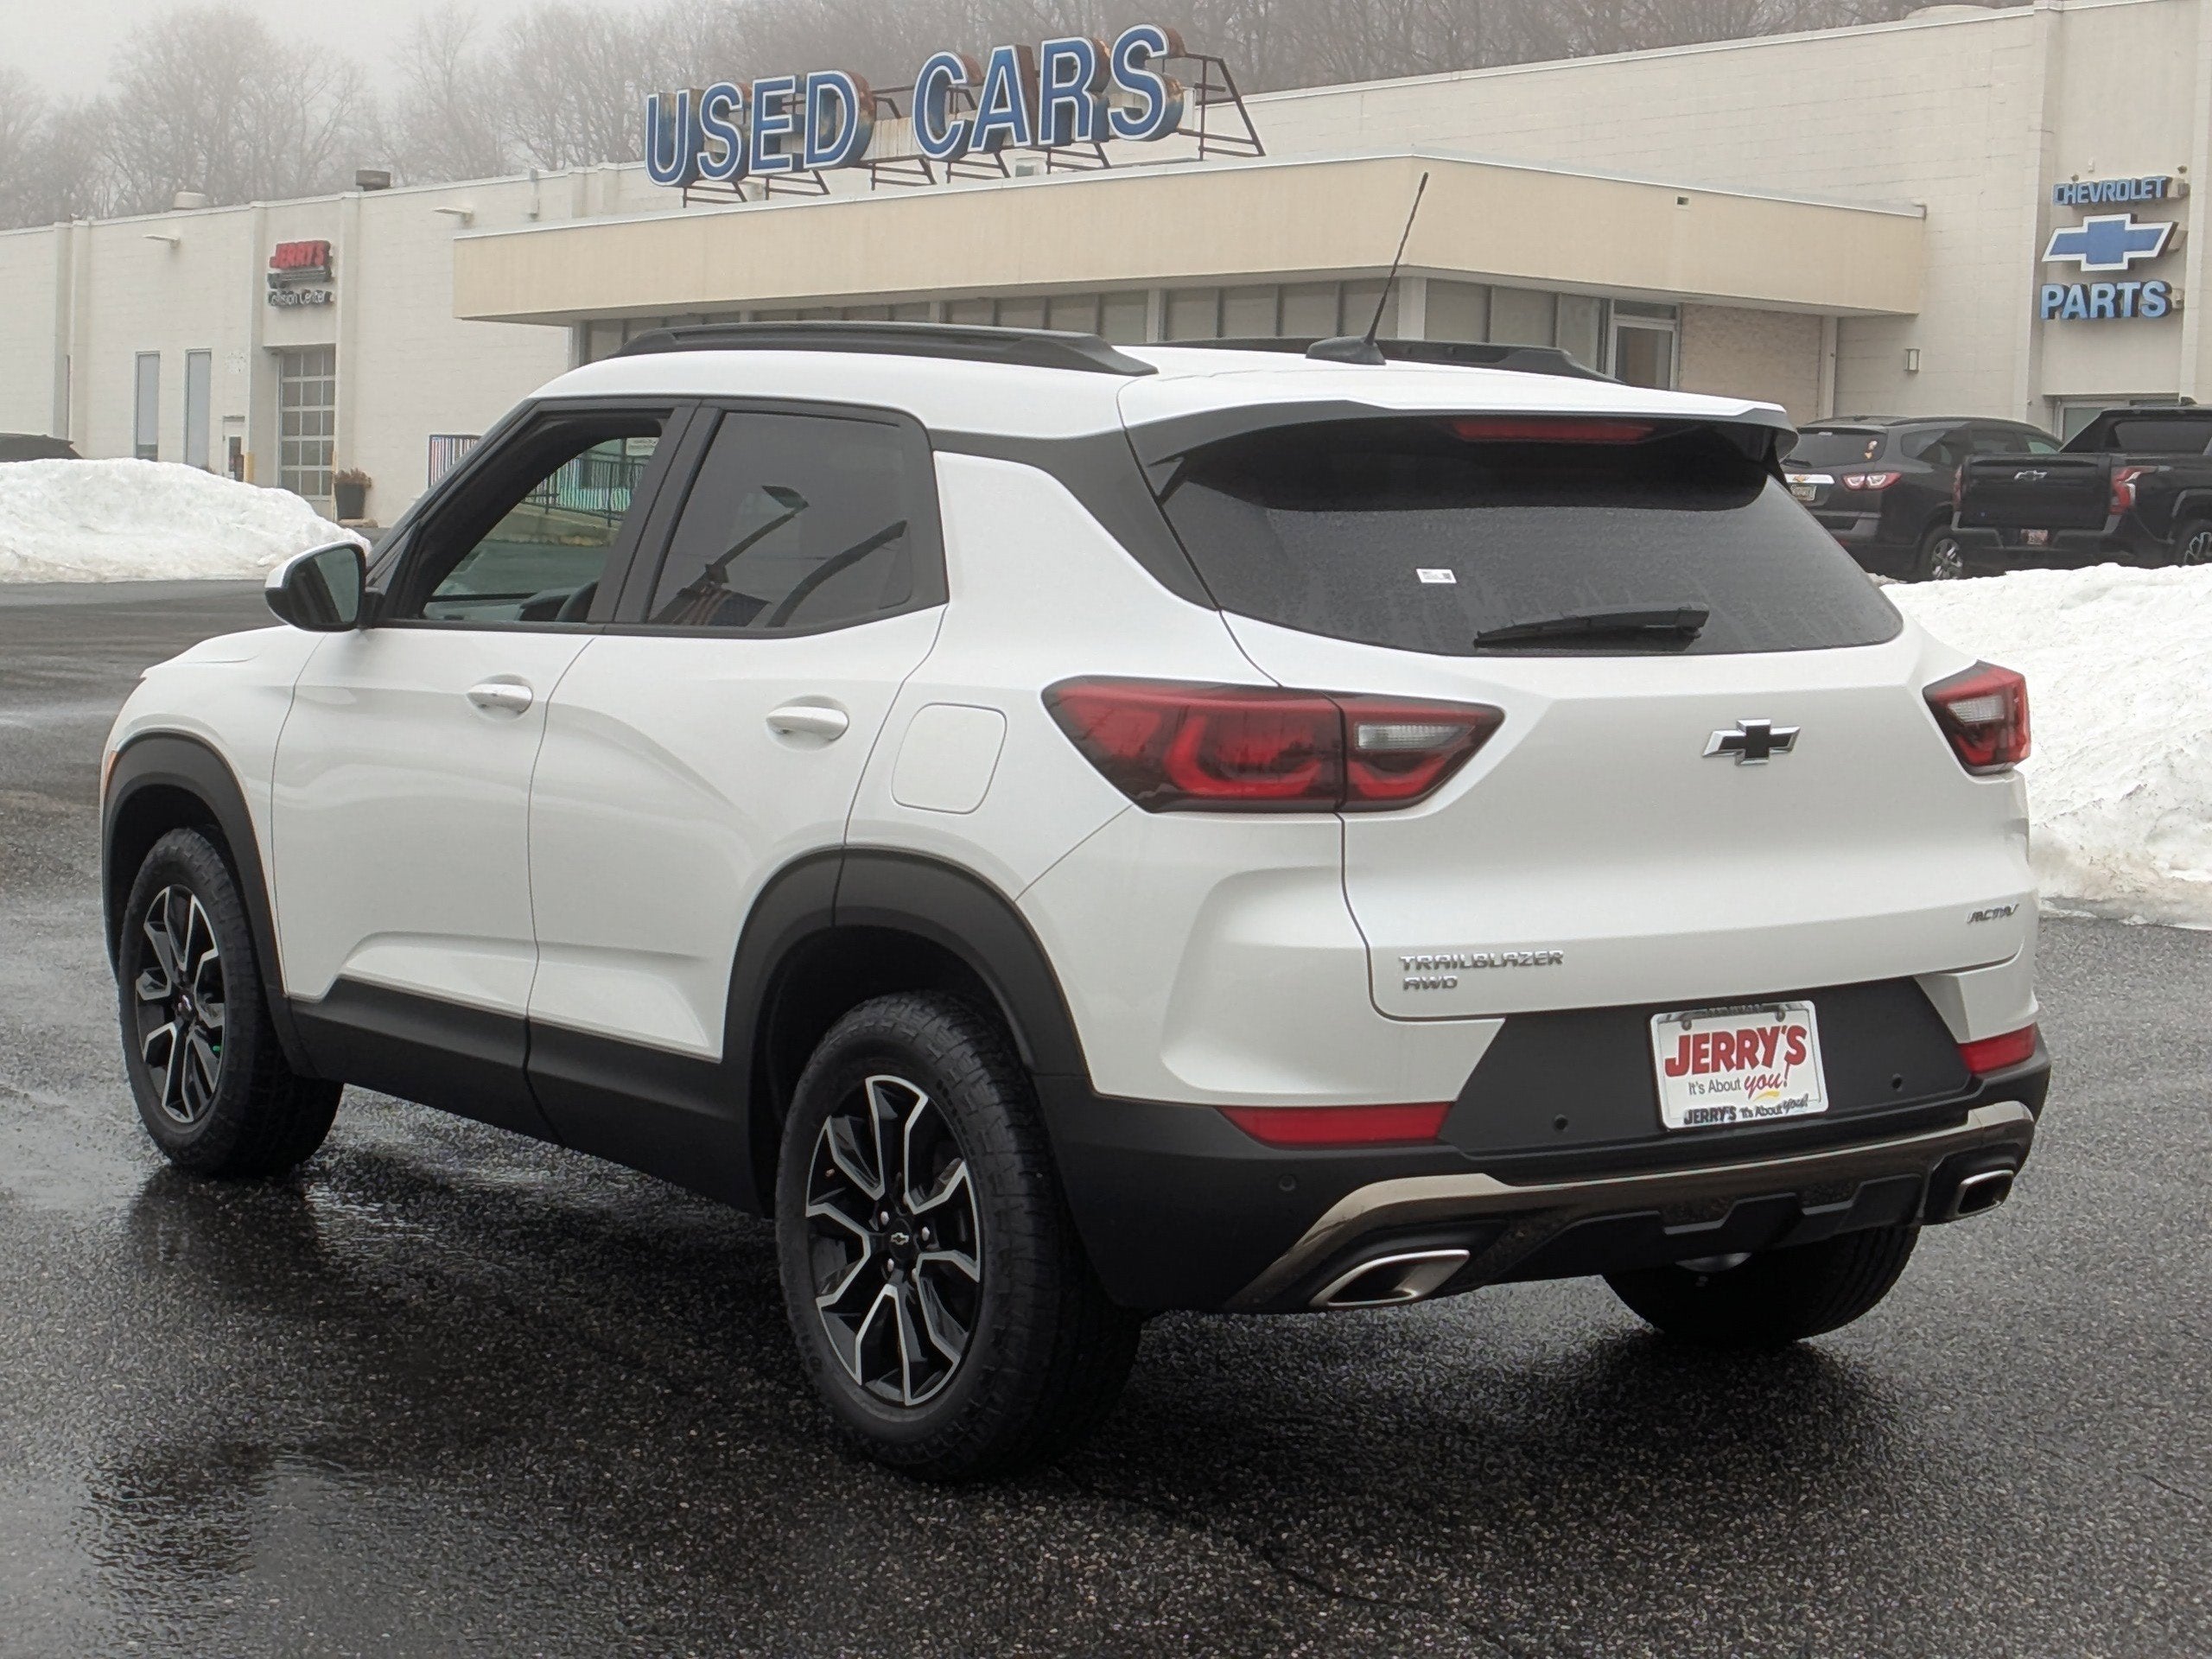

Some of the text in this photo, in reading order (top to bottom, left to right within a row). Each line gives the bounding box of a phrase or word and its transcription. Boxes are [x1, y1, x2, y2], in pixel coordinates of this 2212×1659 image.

[645, 22, 1182, 188] USED CARS
[2052, 175, 2170, 207] CHEVROLET
[2040, 279, 2170, 321] PARTS
[1398, 949, 1565, 971] TRAILBLAZER
[1402, 975, 1459, 991] AWD
[1664, 1024, 1808, 1078] JERRY'S
[1688, 1064, 1789, 1100] It's About you!
[1683, 1105, 1738, 1125] JERRY'S
[1755, 1103, 1783, 1117] About
